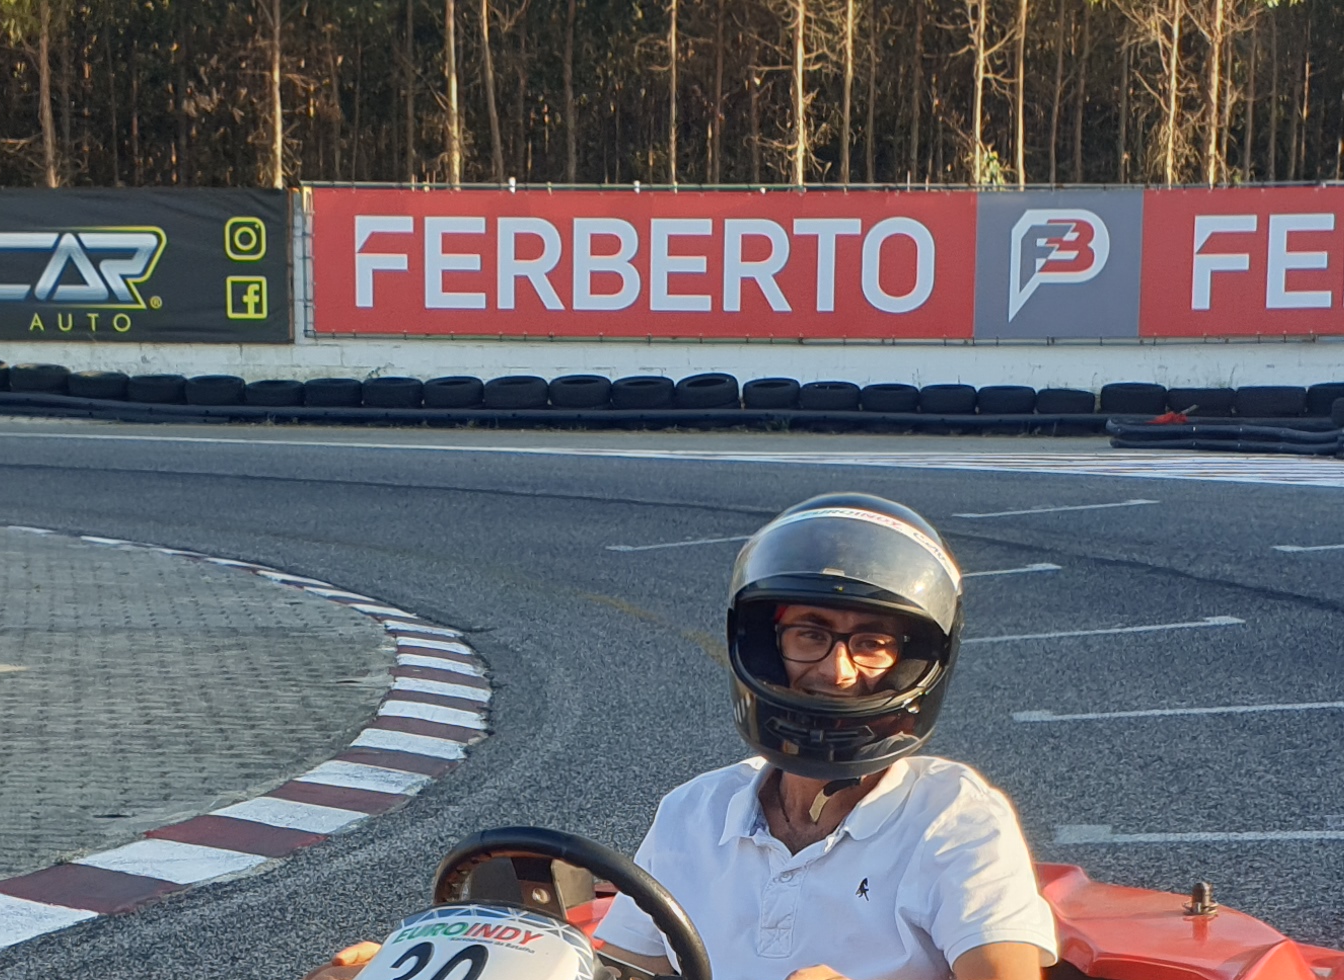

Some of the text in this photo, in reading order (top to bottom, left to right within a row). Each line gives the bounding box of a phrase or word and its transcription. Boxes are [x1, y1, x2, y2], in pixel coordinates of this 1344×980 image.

[354, 215, 936, 313] FERBERTO
[29, 312, 132, 332] AUTO
[392, 921, 544, 946] EUROINDY
